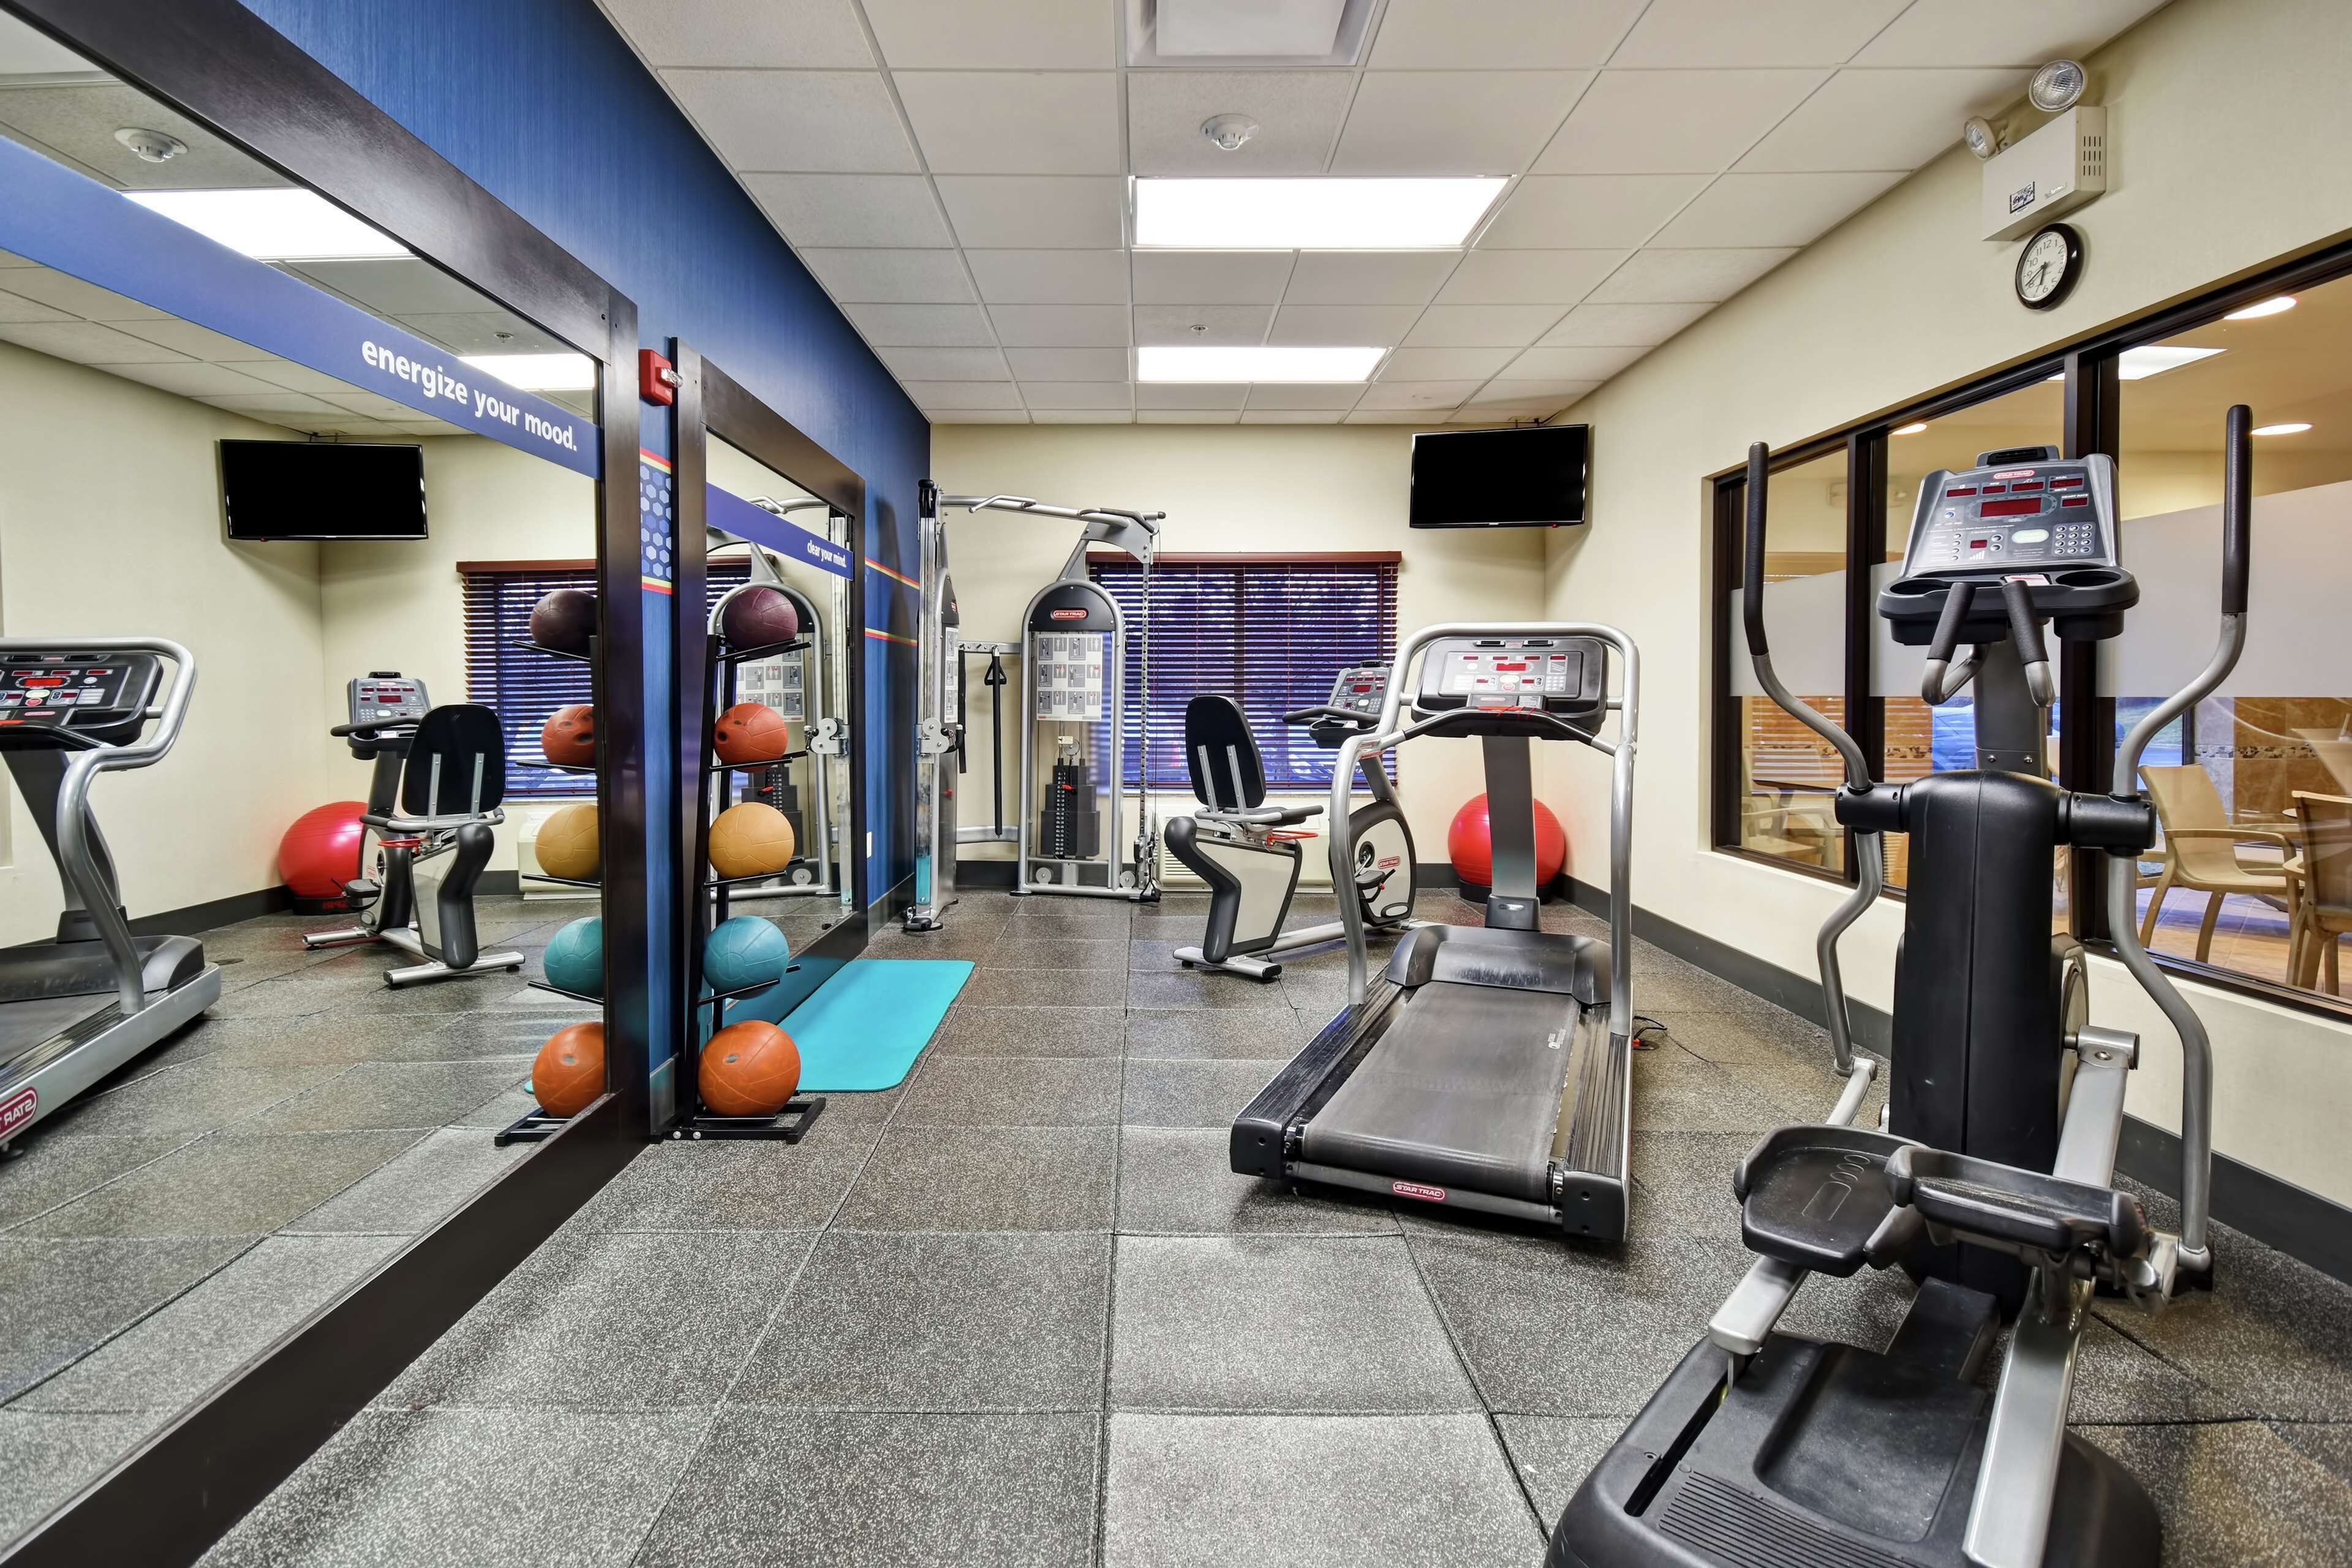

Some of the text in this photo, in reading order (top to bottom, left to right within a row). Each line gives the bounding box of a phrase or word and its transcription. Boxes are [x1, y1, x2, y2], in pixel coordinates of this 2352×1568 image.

[2044, 239, 2052, 249] 12
[2036, 247, 2042, 256] 11
[2029, 257, 2038, 267] 10
[362, 341, 577, 451] energize your mood.
[807, 540, 820, 557] clear
[821, 548, 832, 562] your
[1419, 1188, 1441, 1197] TRAC
